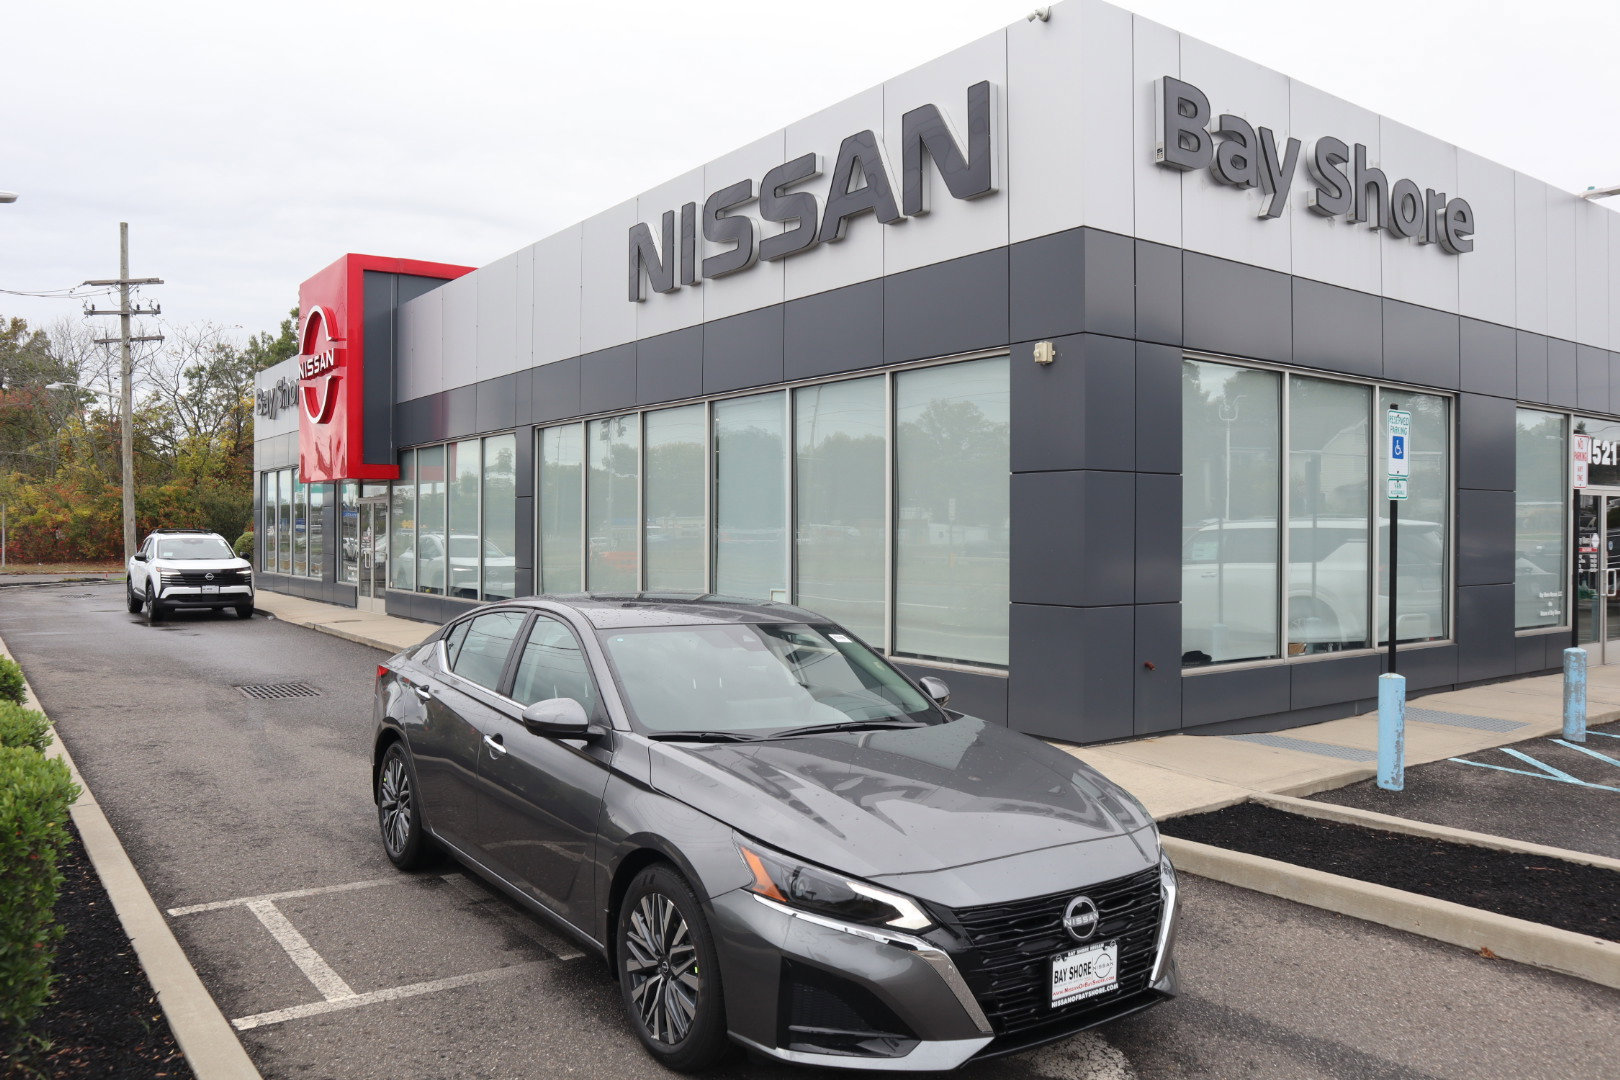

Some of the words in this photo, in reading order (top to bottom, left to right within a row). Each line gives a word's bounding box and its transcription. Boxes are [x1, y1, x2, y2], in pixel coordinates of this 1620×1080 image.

[1154, 75, 1301, 219] Bay
[1306, 135, 1475, 254] Shore
[629, 80, 998, 302] NISSAN
[299, 348, 335, 380] NISSAN
[257, 387, 276, 420] Bay
[275, 376, 299, 406] Shor
[1389, 415, 1409, 426] RESERVED
[1390, 426, 1408, 435] PARKING
[1577, 440, 1584, 450] NO
[1574, 450, 1588, 461] PARKING
[1064, 911, 1099, 927] NISSAN
[1054, 968, 1068, 984] BAY
[1069, 961, 1092, 980] SHORE
[1092, 962, 1114, 971] NISSAN
[1051, 983, 1119, 1008] NISSANOFBAYSHORE.COM
